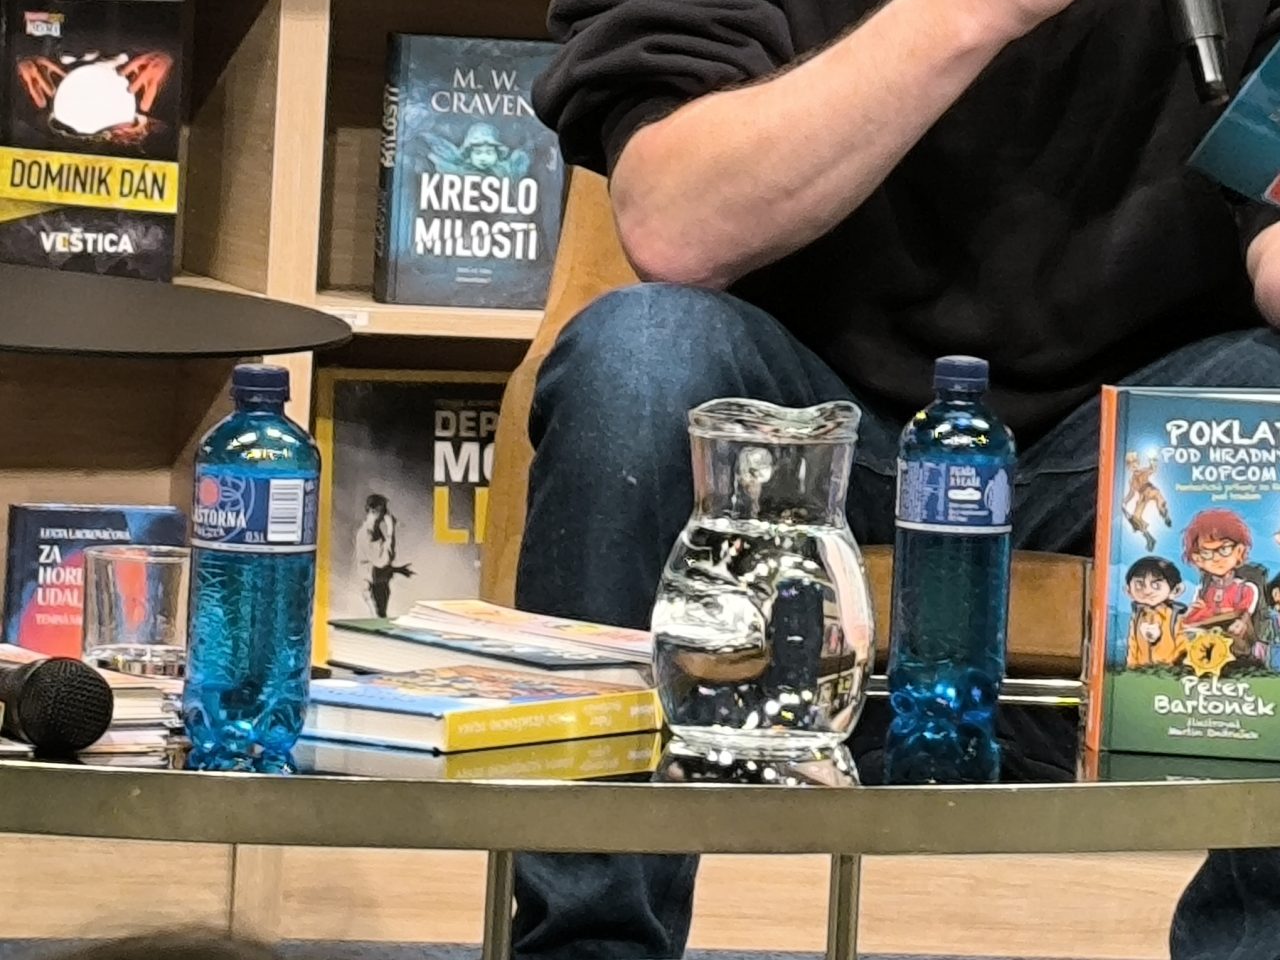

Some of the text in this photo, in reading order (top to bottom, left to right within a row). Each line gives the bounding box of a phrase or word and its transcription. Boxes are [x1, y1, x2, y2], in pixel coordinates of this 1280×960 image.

[452, 67, 483, 90] M.
[431, 91, 535, 117] CRAVEN
[10, 158, 166, 200] DOMINIK DÁN
[419, 172, 538, 215] KRESLO
[40, 227, 134, 254] VEŠTICA
[414, 217, 537, 261] MILOSTI
[434, 410, 500, 437] DEP
[1160, 447, 1201, 463] POD
[1191, 465, 1277, 481] KOPCOM
[433, 486, 489, 544] LI
[38, 545, 62, 563] ZA
[38, 566, 84, 585] HORI
[37, 587, 82, 607] UDAL
[1181, 675, 1250, 698] Peter
